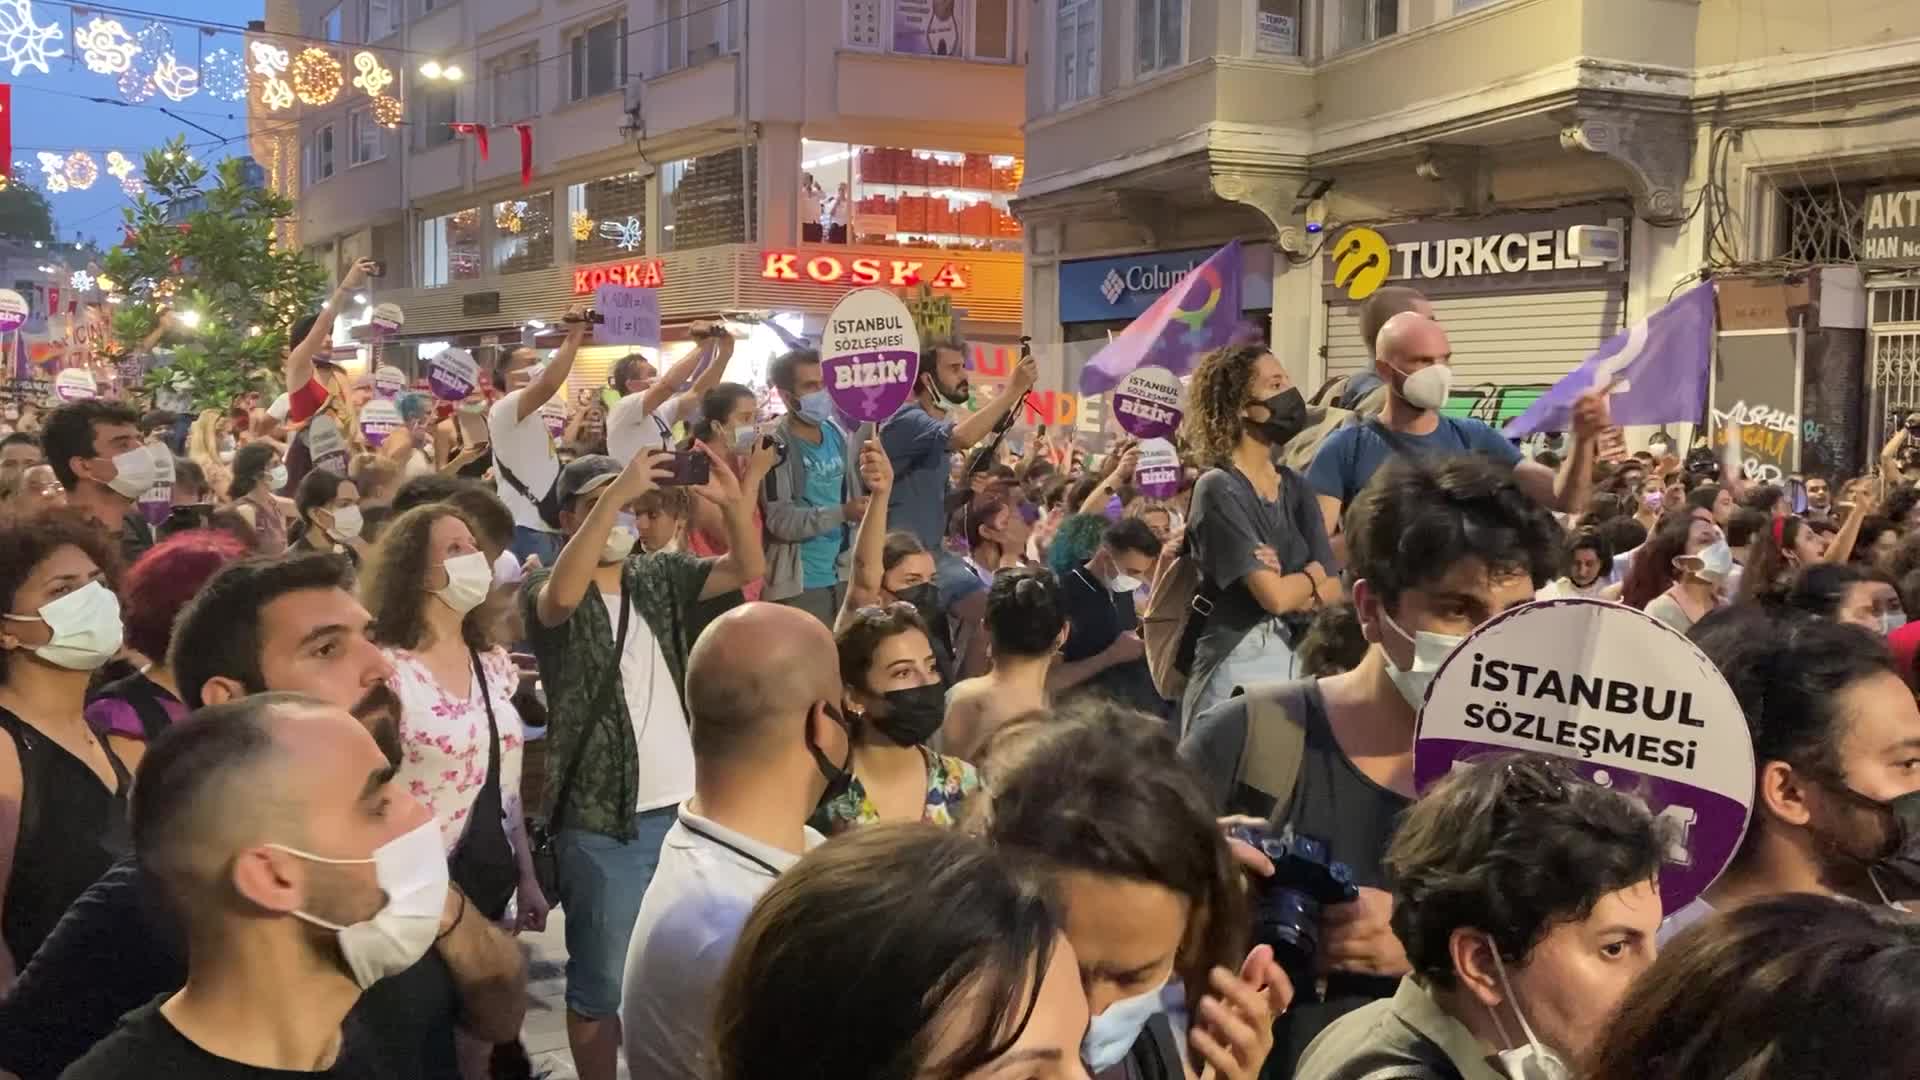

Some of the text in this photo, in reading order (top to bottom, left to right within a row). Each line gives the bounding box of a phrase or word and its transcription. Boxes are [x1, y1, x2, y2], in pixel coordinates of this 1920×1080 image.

[1865, 236, 1899, 259] HAN
[574, 261, 661, 293] KOSKA
[761, 253, 967, 288] KOSKA
[833, 353, 908, 390] BİZİM
[1119, 398, 1175, 425] BİZİM
